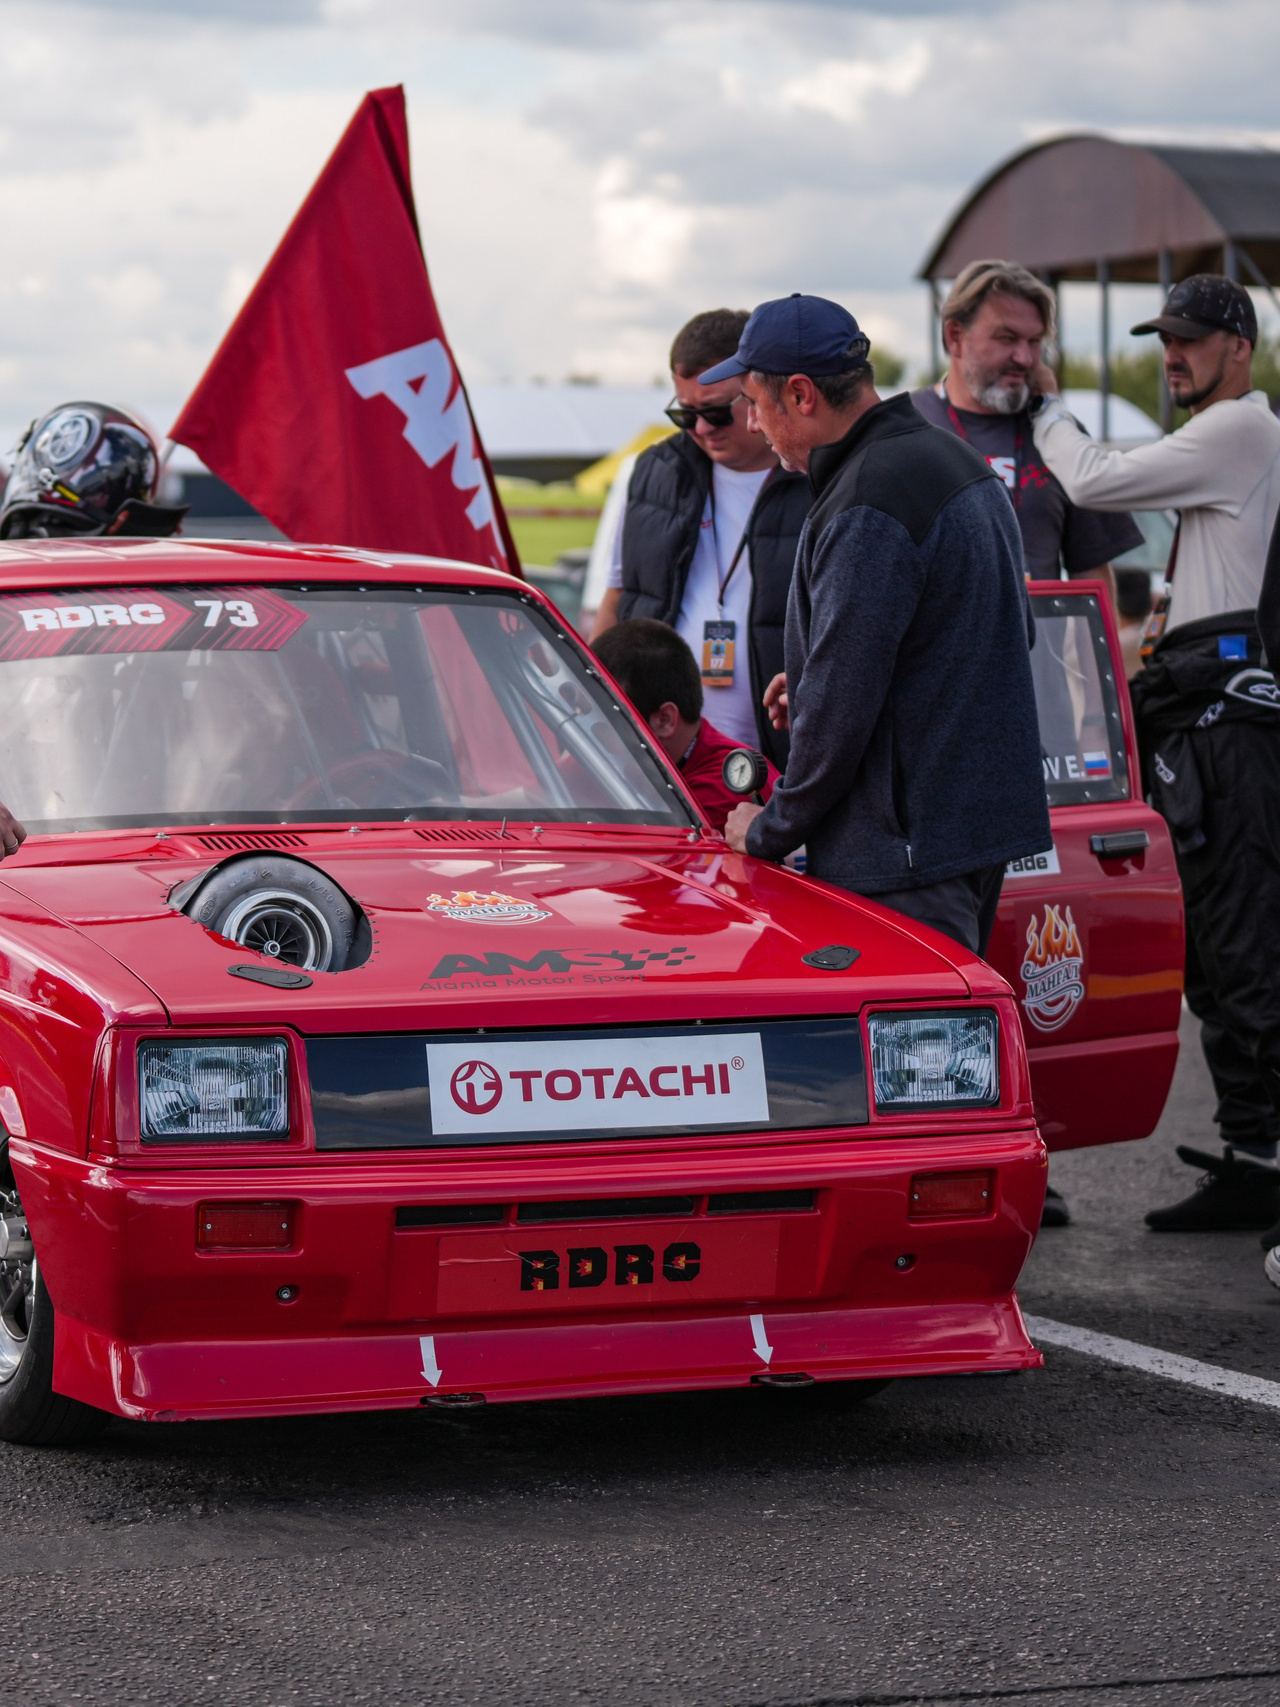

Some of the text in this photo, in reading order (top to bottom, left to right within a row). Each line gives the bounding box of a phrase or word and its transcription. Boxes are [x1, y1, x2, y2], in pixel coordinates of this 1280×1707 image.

[344, 337, 508, 572] AM
[19, 600, 259, 632] RDRC 73
[428, 948, 647, 979] AMS
[419, 973, 647, 992] Alania Motor Sport
[1026, 964, 1079, 999] МАНГАЛ
[518, 1241, 702, 1291] RDRC
